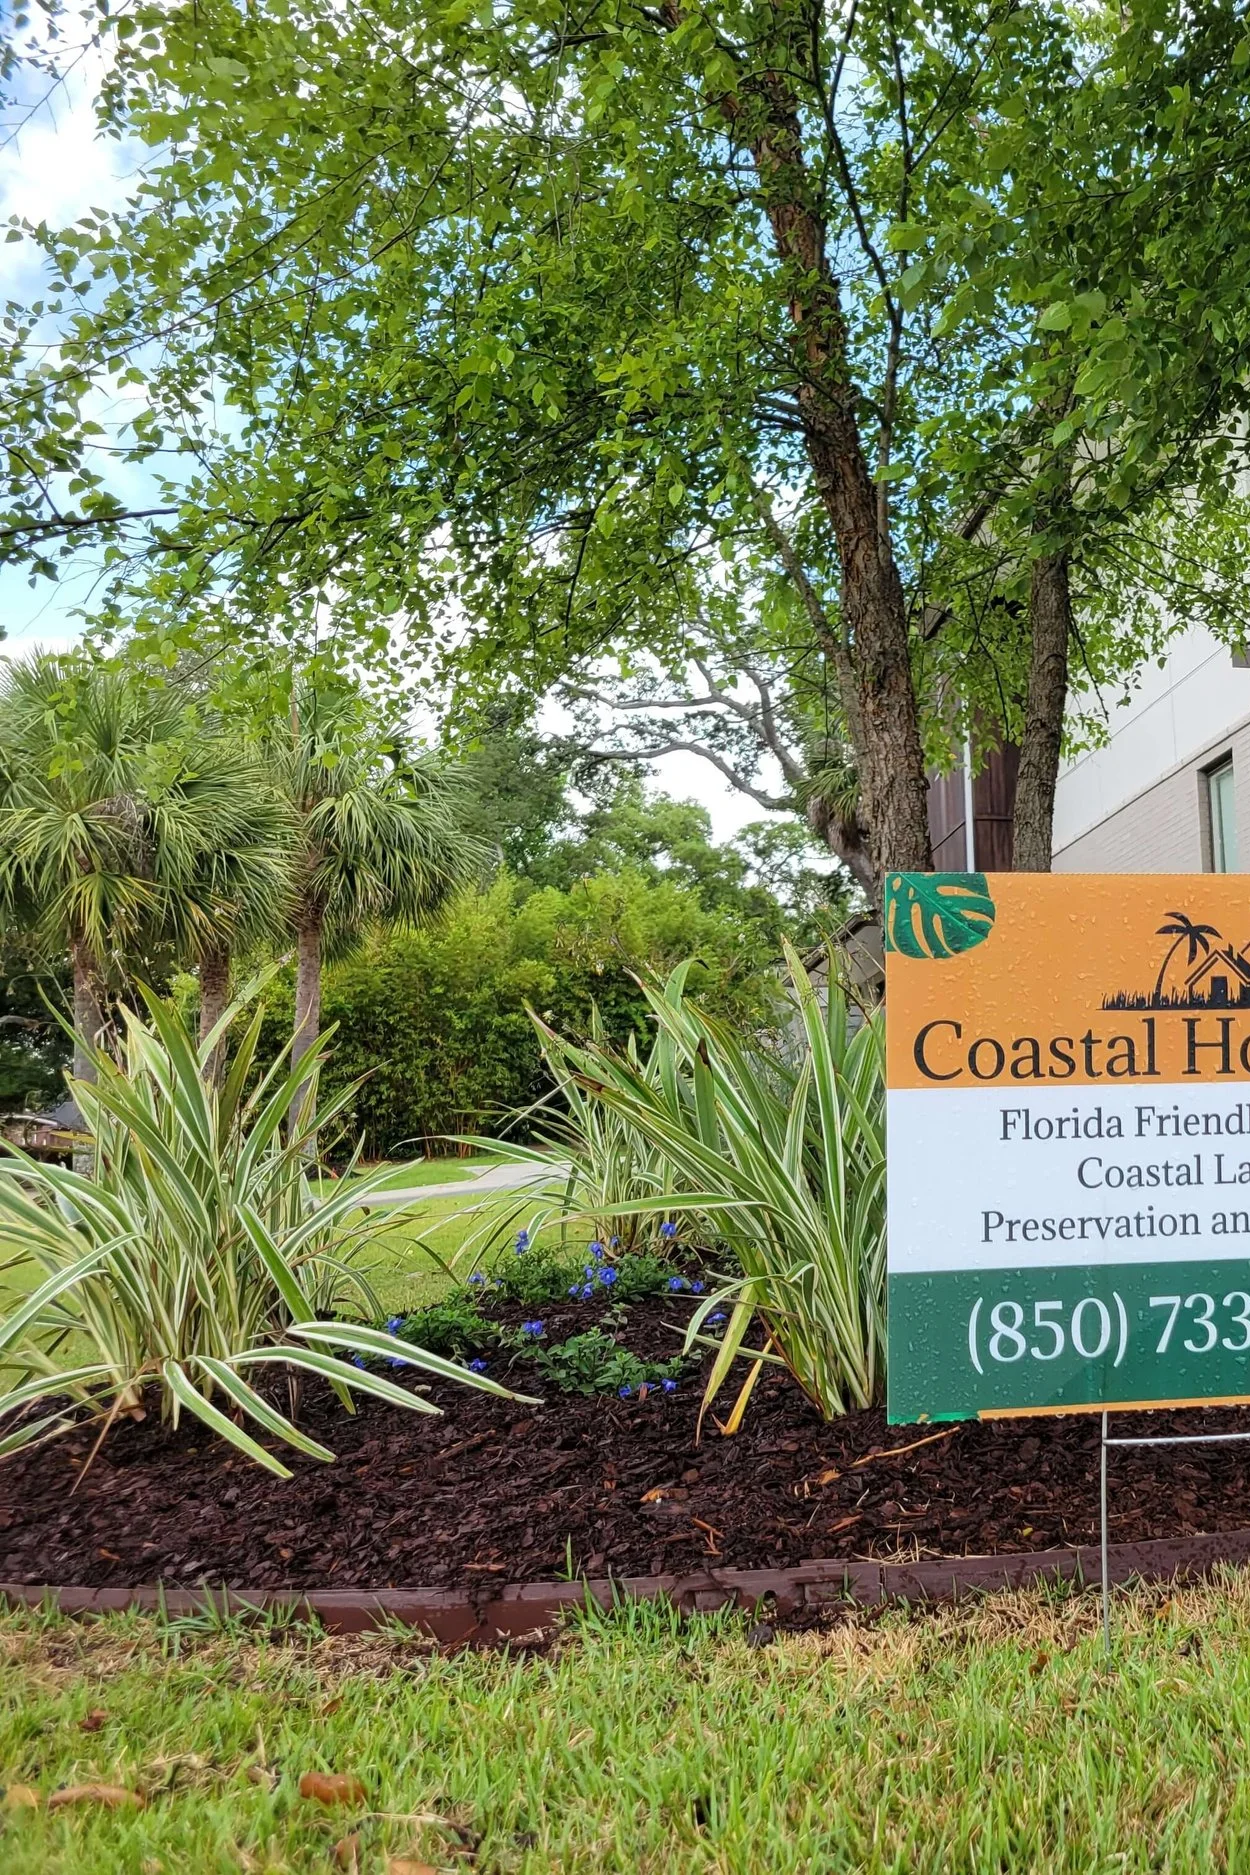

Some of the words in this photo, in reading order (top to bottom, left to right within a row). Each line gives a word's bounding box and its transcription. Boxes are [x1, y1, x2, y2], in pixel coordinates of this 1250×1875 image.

[913, 1017, 1160, 1080] Coastal
[999, 1106, 1123, 1141] Florida
[1077, 1154, 1203, 1189] Coastal
[981, 1207, 1200, 1243] Preservation
[968, 1292, 1130, 1375] (850)
